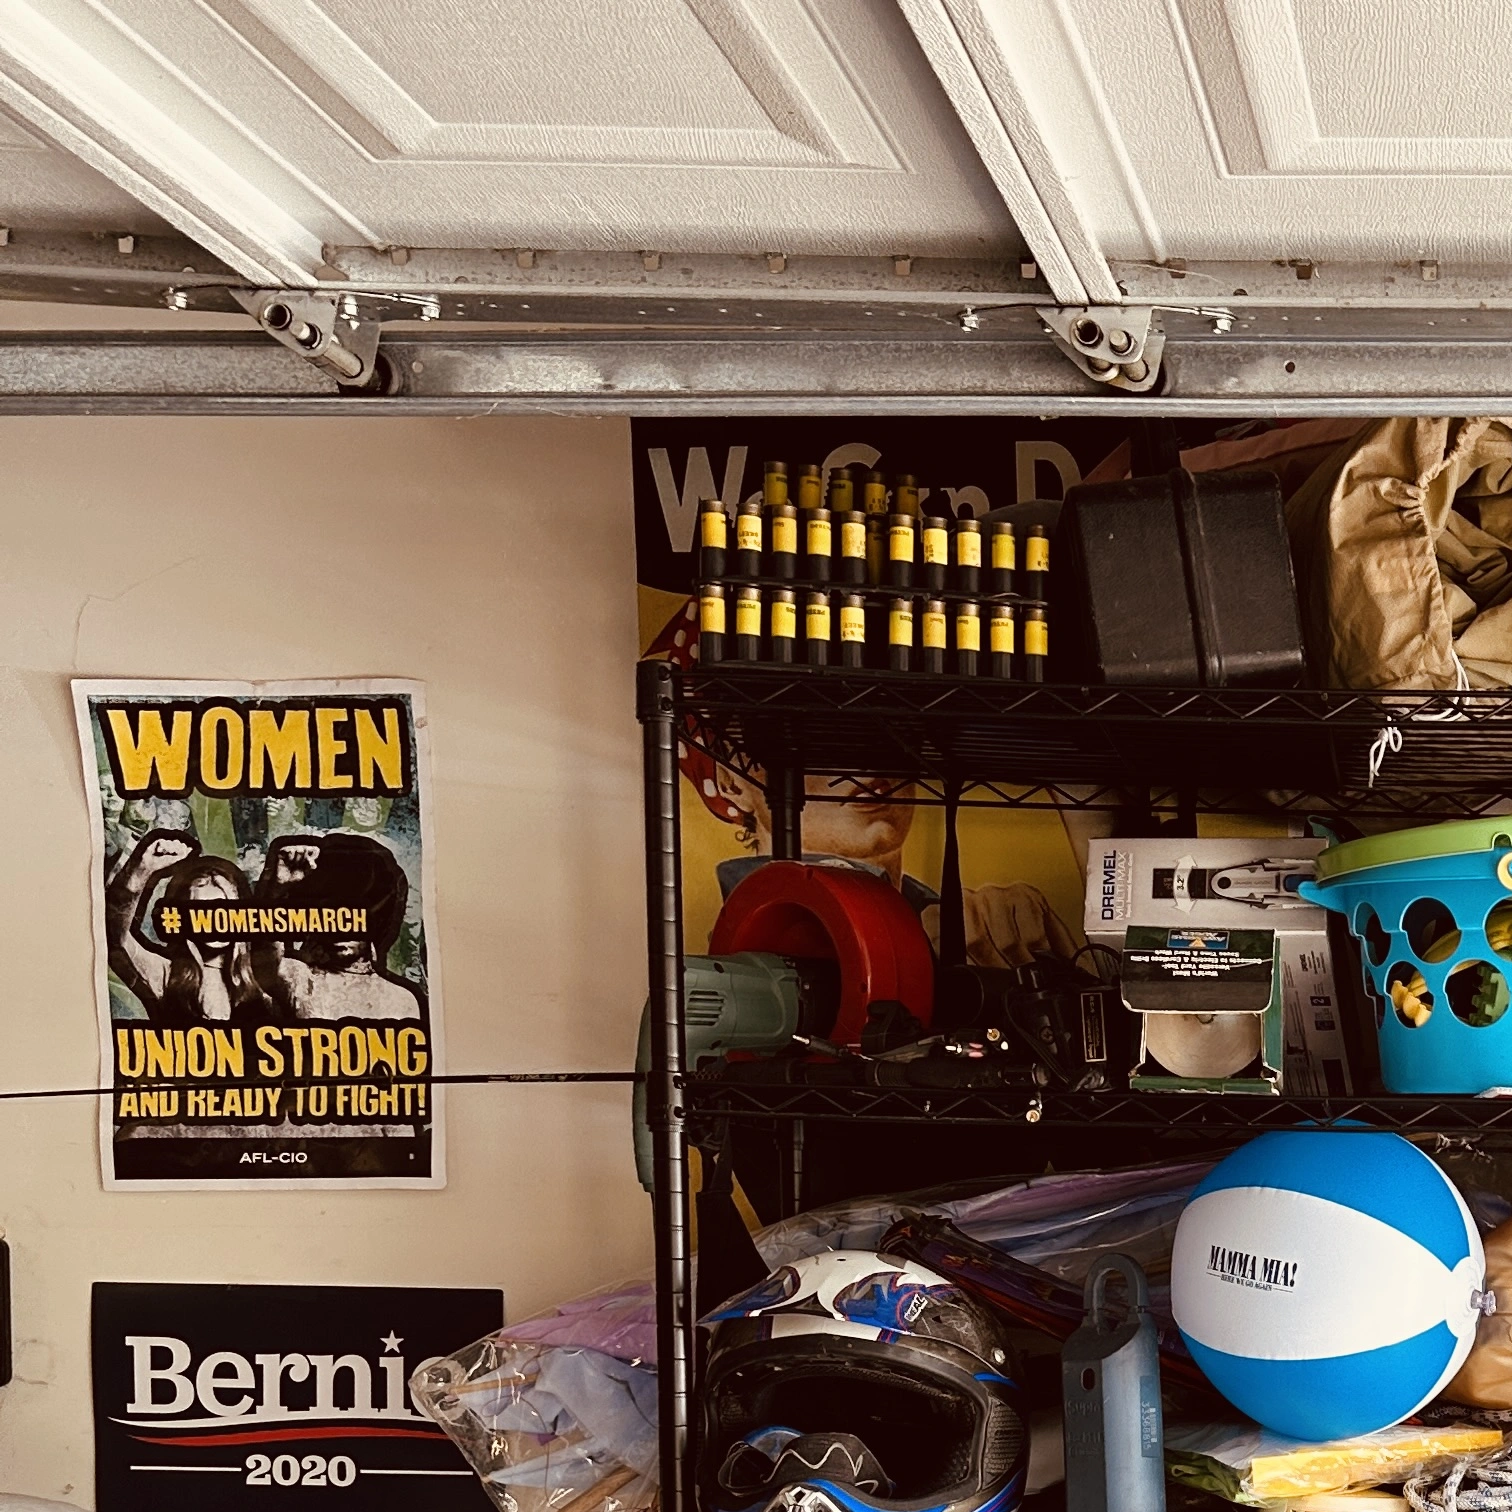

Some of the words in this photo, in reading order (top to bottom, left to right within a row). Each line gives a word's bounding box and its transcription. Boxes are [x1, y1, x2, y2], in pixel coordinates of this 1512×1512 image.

[107, 707, 402, 791] WOMEN
[1102, 850, 1117, 921] DREMEL
[160, 907, 182, 934] #
[189, 907, 367, 934] WOMENSMARCH
[116, 1028, 243, 1079] UNION
[256, 1026, 427, 1079] STRONG
[119, 1083, 178, 1118] AND
[187, 1083, 282, 1118] READY
[296, 1085, 328, 1117] TO
[336, 1083, 427, 1117] FIGHT!
[240, 1152, 307, 1165] AFL-CIO
[1207, 1245, 1257, 1280] MAMMA
[1259, 1257, 1298, 1287] MIA!
[246, 1454, 357, 1488] 2020
